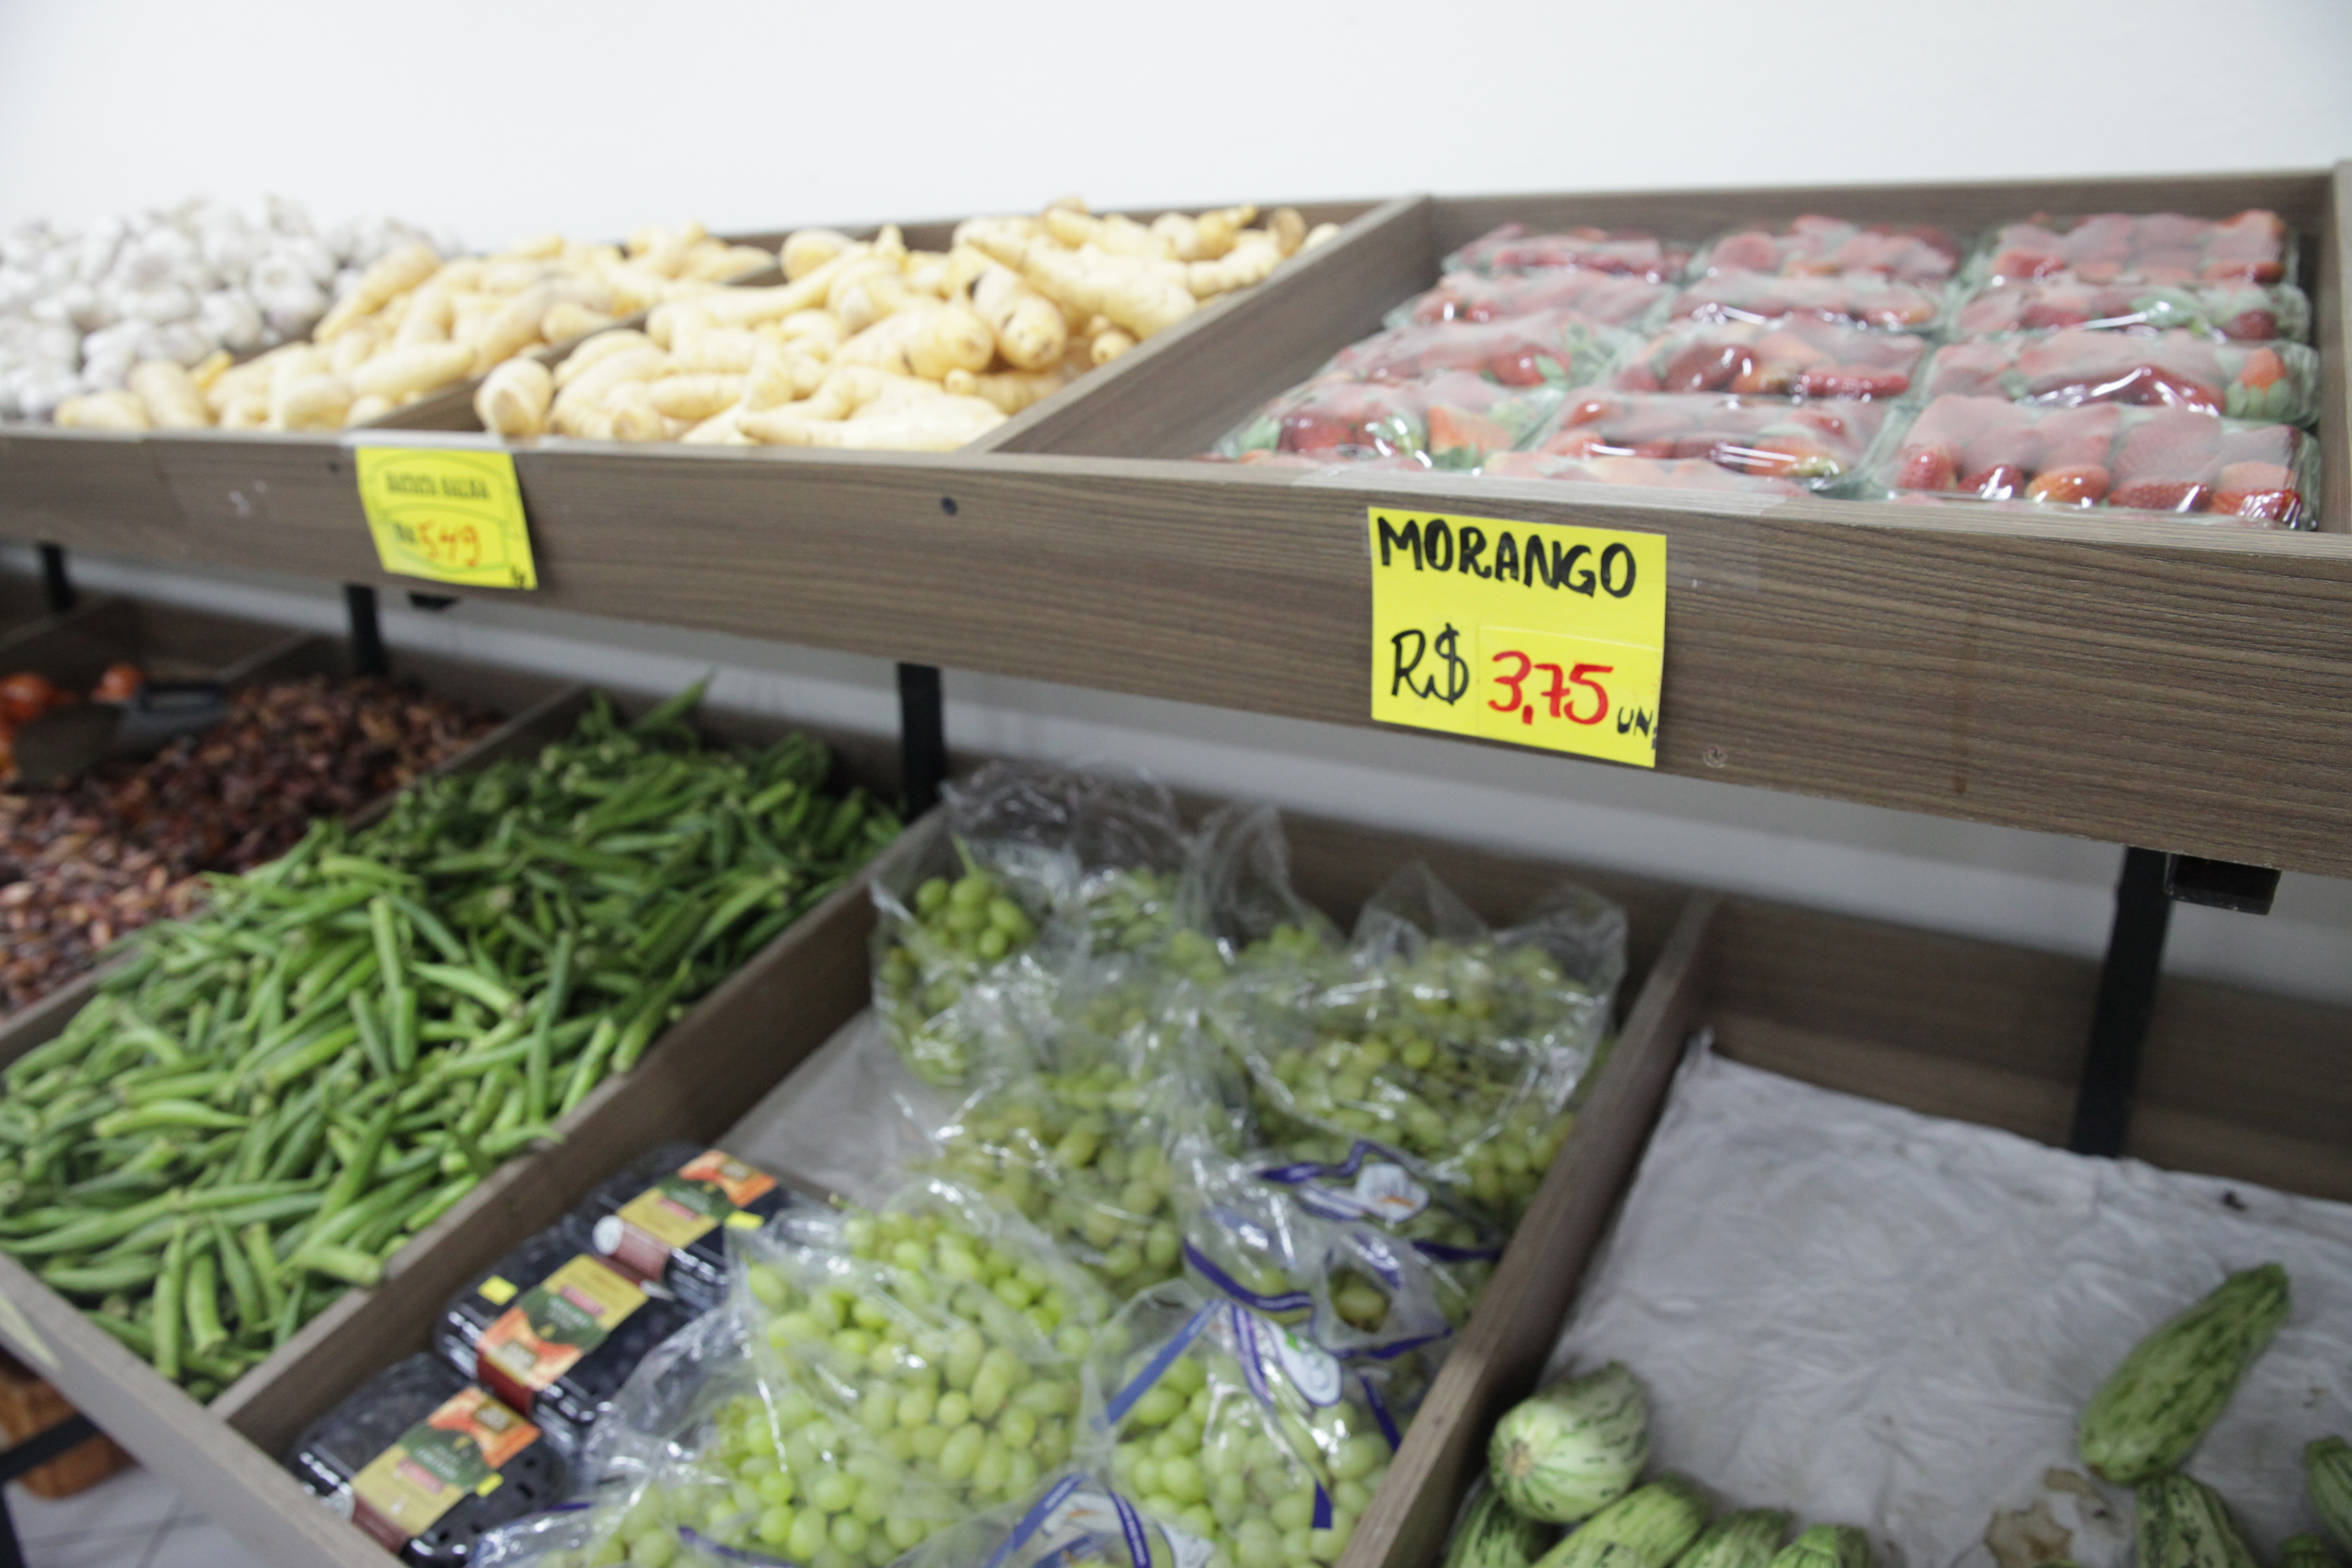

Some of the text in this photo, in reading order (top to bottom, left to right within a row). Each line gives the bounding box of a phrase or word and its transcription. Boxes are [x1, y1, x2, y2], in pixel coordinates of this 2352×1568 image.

[1377, 516, 1636, 598] MORANGO
[1391, 623, 1653, 738] R$ 3,75 UN
